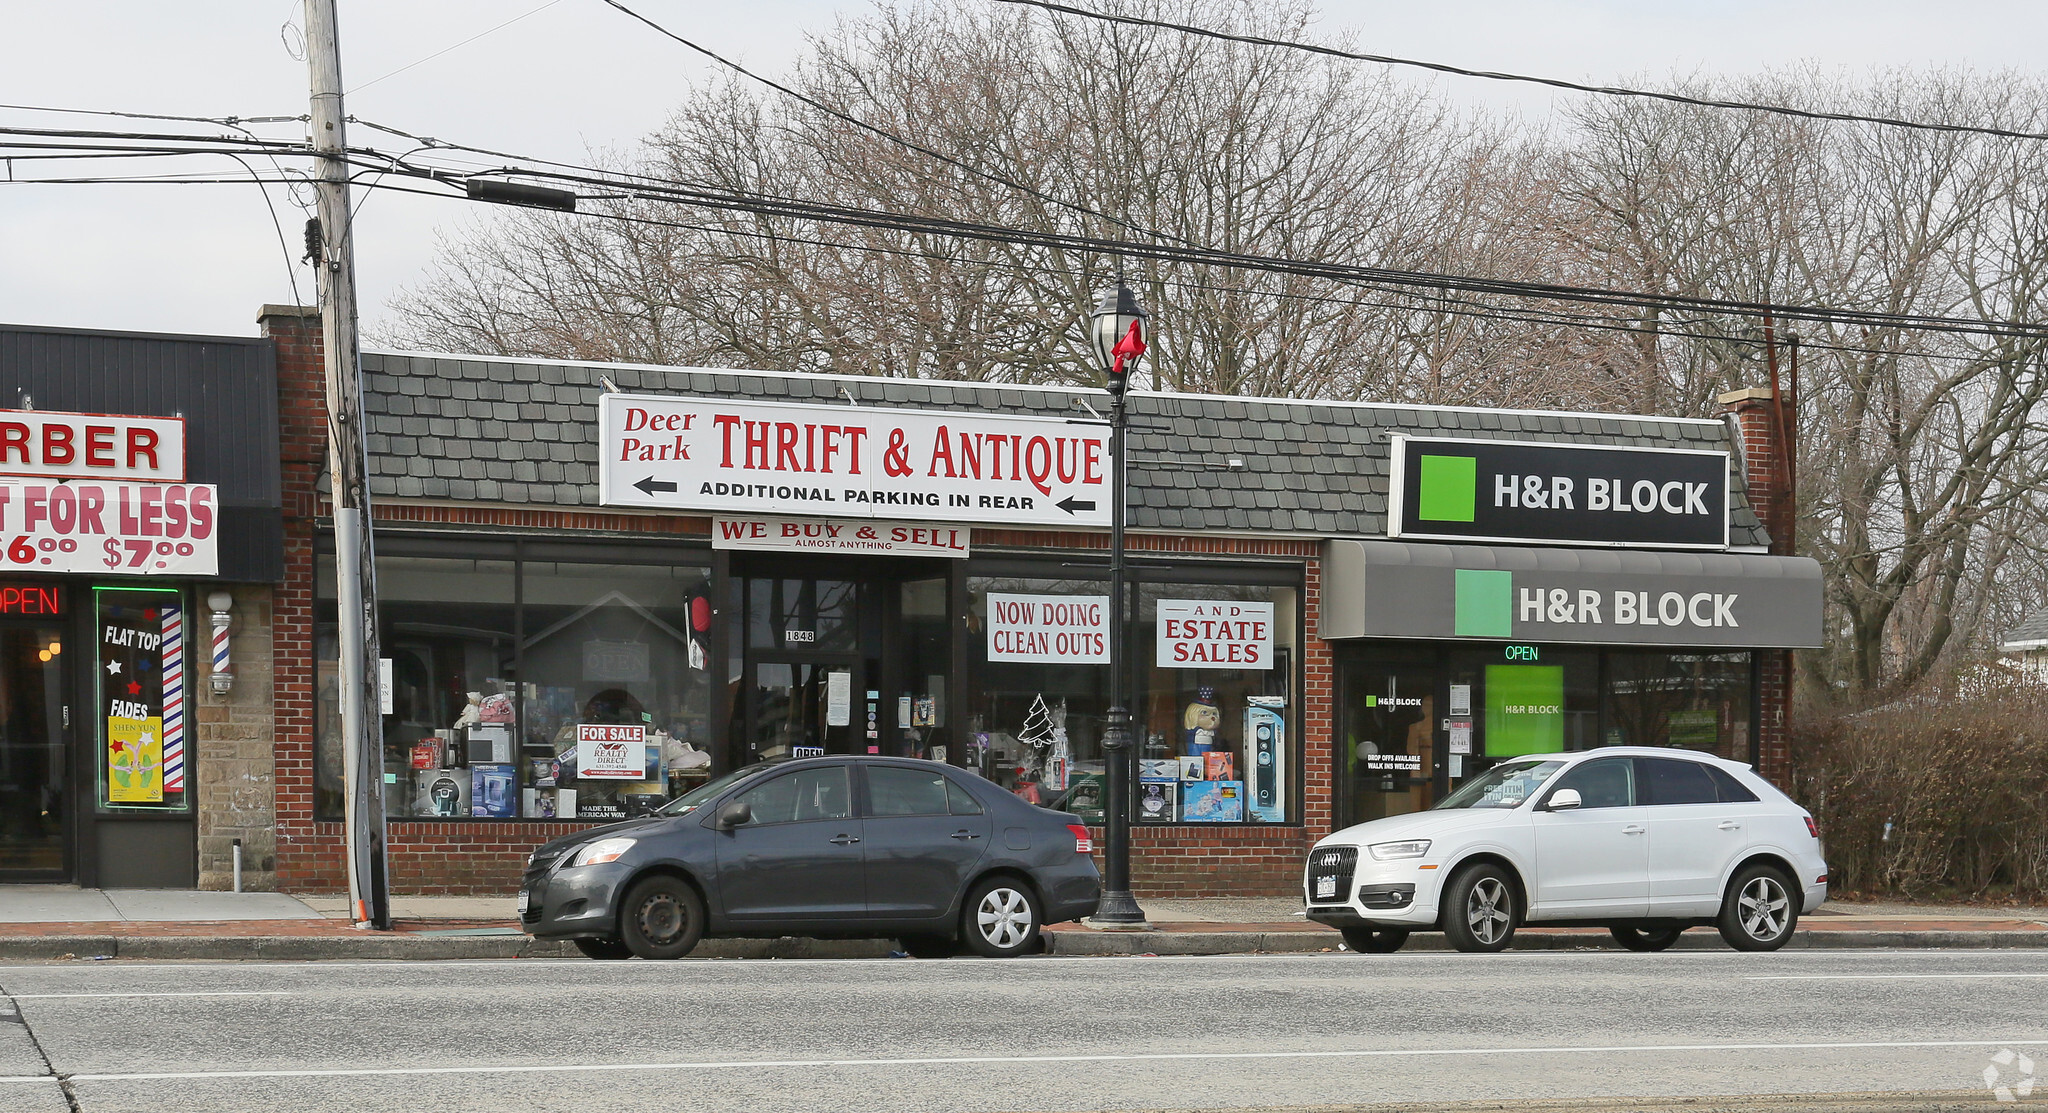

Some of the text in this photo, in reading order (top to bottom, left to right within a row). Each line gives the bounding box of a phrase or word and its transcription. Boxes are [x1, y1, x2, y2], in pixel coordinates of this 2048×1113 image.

[623, 407, 697, 432] Deer
[619, 436, 692, 462] Park
[713, 414, 1103, 497] THRIFT & ANTIQUE
[699, 481, 1034, 509] ADDITIONAL PARKING IN REAR
[1494, 473, 1710, 515] H&R BLOCK
[24, 485, 106, 535] FOR
[118, 485, 213, 539] LESS
[719, 520, 965, 551] WE BUY & SELL
[795, 539, 893, 550] ALMOST ANYTHING
[995, 601, 1101, 627] NOW DOING
[1194, 605, 1241, 617] AND
[1519, 587, 1740, 628] H&R BLOCK
[105, 625, 161, 651] FLAT TOP
[787, 631, 813, 641] 1848
[1165, 619, 1267, 641] ESTATE
[993, 630, 1104, 656] CLEAN OUTS
[1173, 642, 1260, 663] SALES
[1505, 645, 1539, 661] OPEN
[110, 698, 148, 722] FADES
[1378, 698, 1422, 706] H&R BLOCK
[1505, 704, 1559, 715] H&R BLOCK
[113, 724, 136, 732] SHEN
[581, 727, 641, 741] FOR SALE
[593, 750, 628, 758] REALTY
[1504, 785, 1522, 793] ITIN
